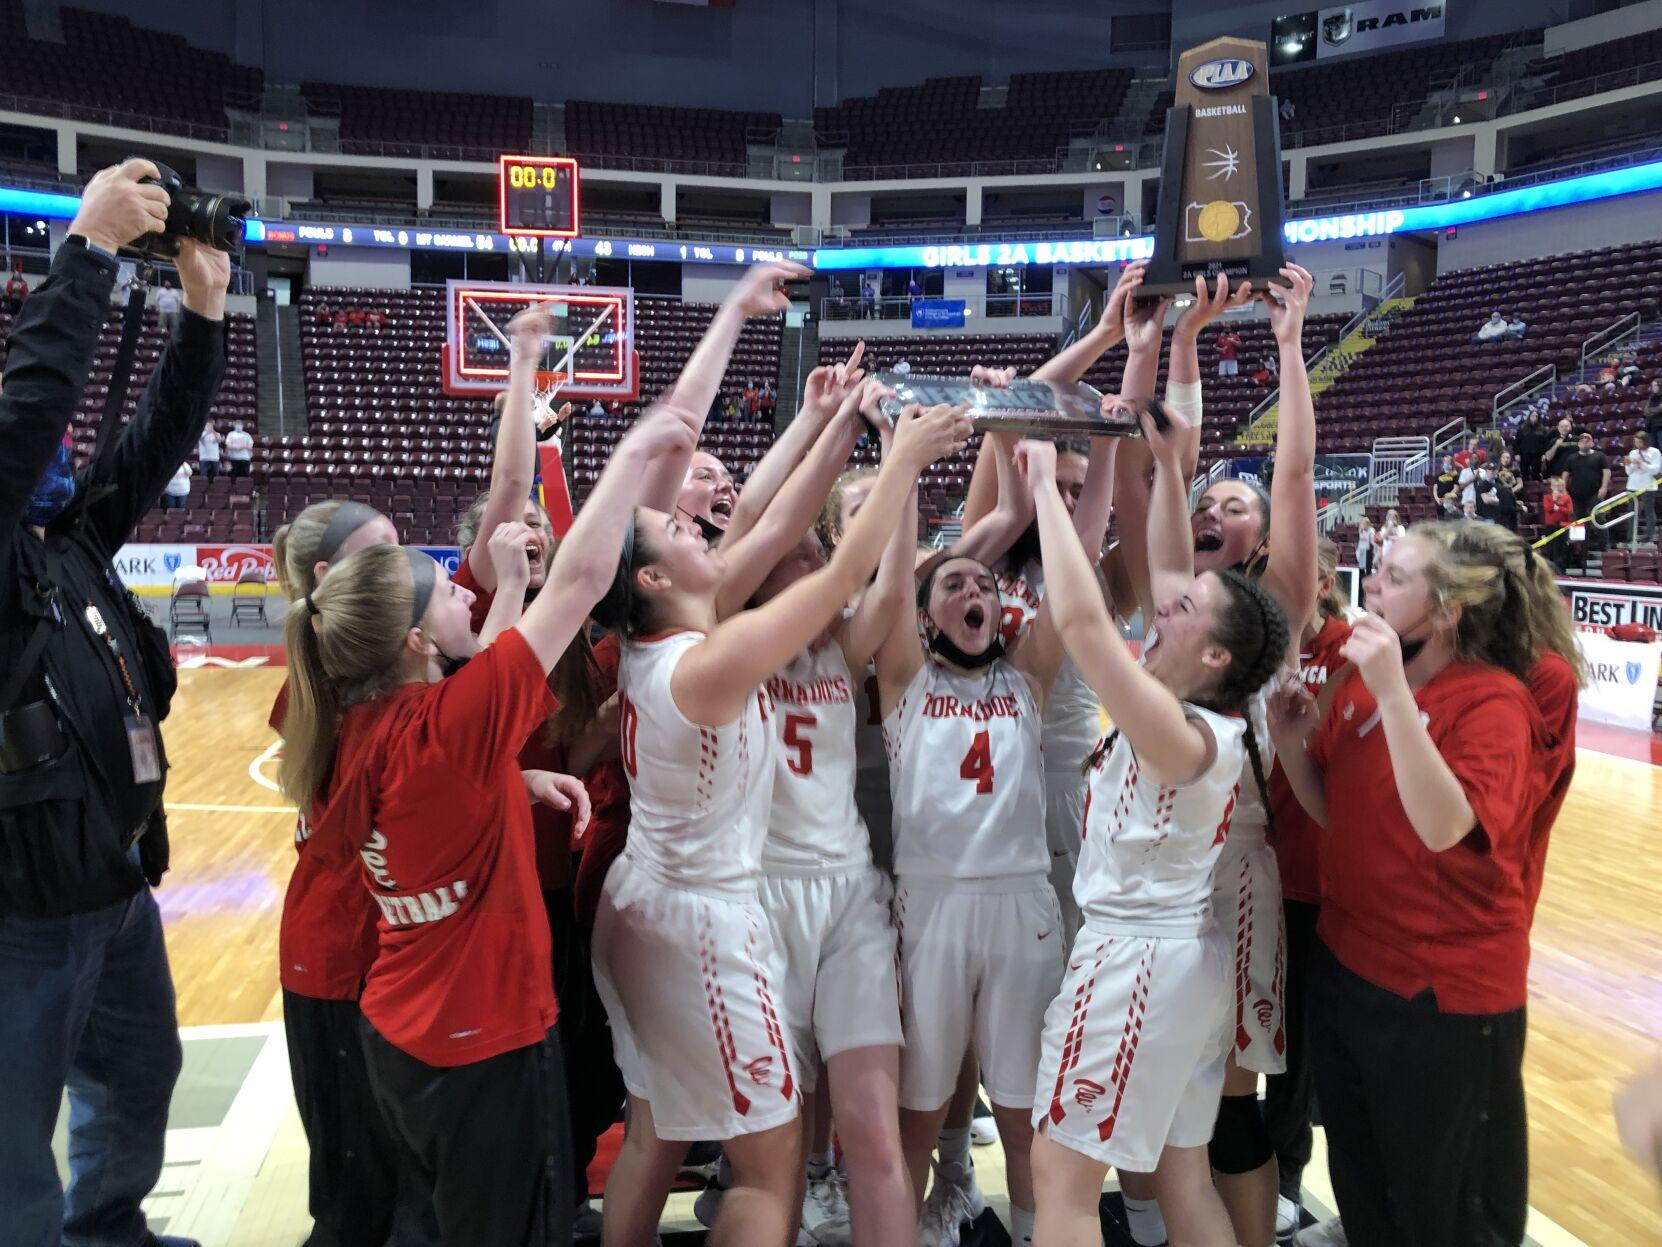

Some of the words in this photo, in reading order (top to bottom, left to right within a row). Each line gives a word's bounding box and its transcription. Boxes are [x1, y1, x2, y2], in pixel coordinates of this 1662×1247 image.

[1356, 6, 1442, 33] RAM
[1193, 61, 1249, 85] PIAA
[1195, 104, 1247, 118] BASKETBALL
[299, 226, 334, 240] FOULS
[1284, 209, 1405, 243] IONSHIP
[922, 244, 990, 267] GIRLS
[997, 243, 1030, 265] 2A
[1573, 595, 1626, 626] BEST
[917, 691, 1020, 721] TORNADOE
[784, 713, 818, 776] 5
[959, 729, 995, 795] 4
